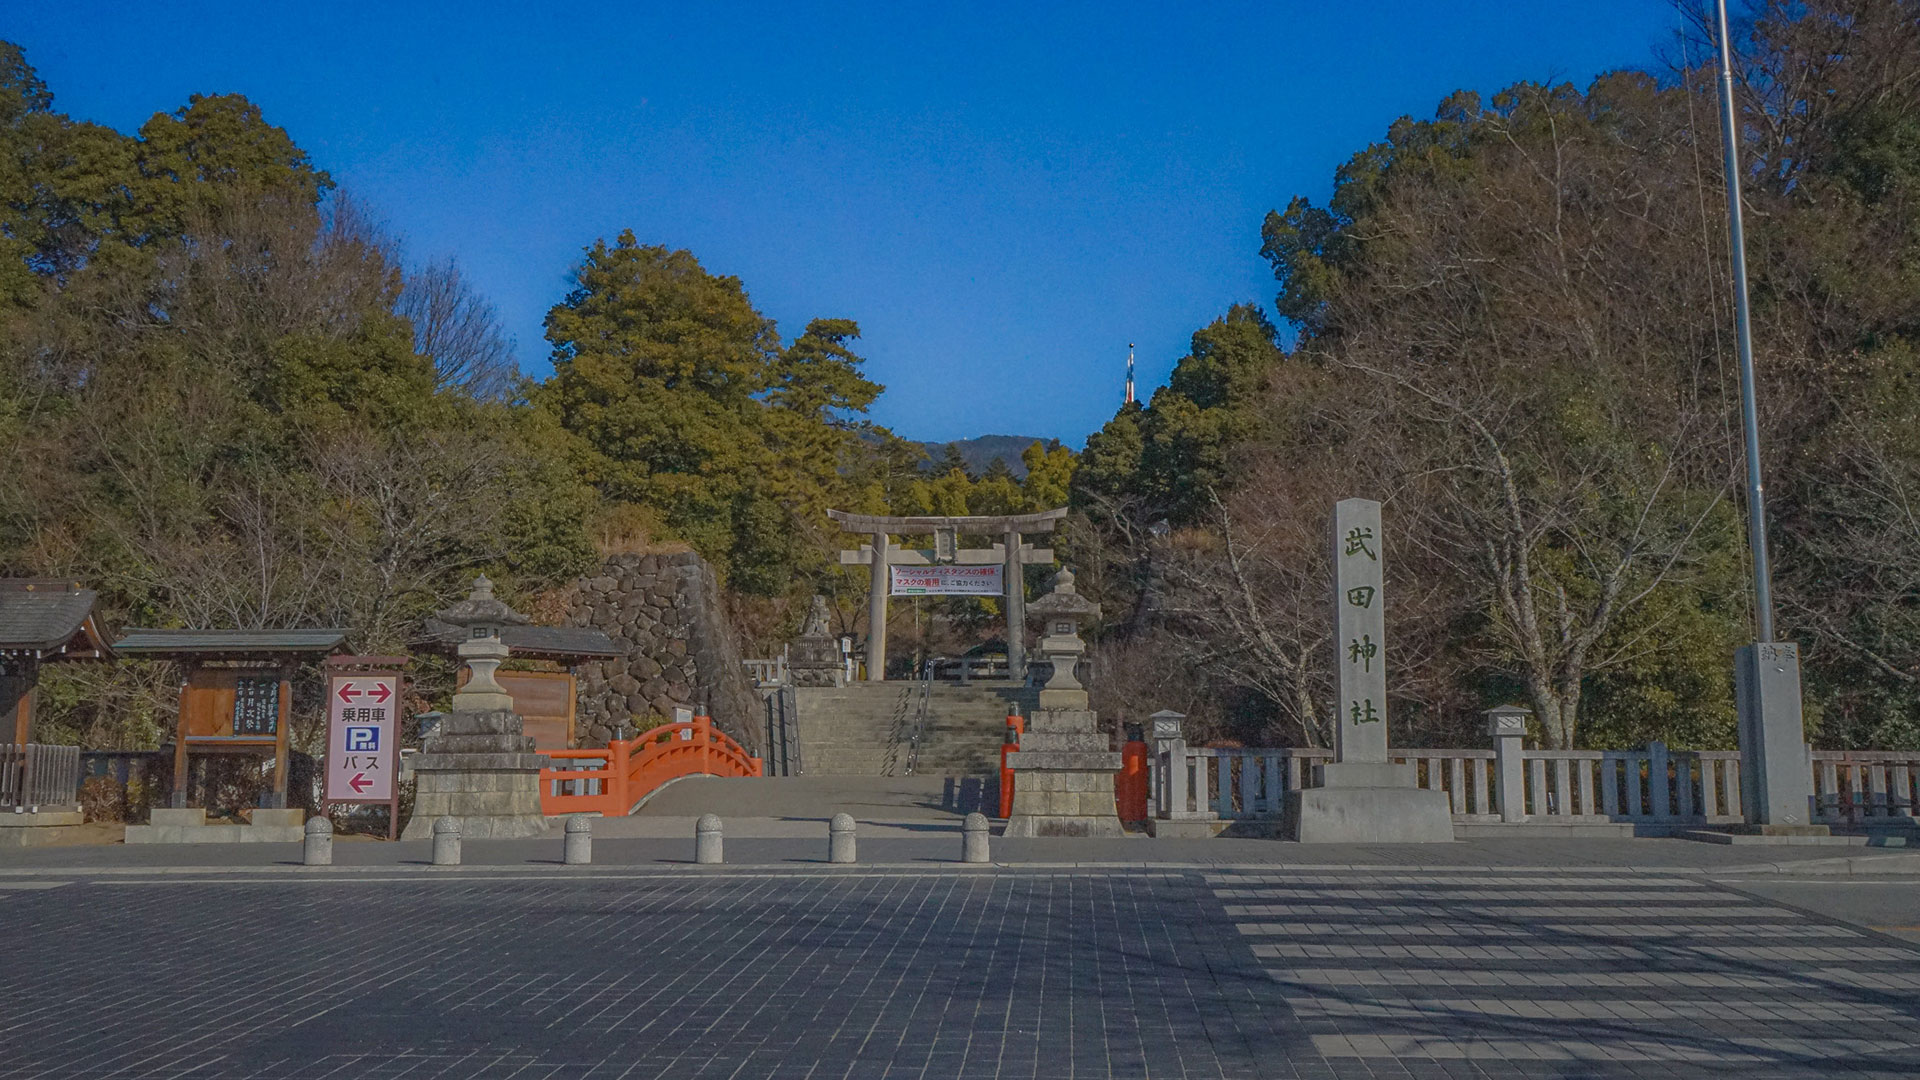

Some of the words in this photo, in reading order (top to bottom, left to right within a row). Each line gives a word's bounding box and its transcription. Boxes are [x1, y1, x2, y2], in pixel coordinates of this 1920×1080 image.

[1345, 527, 1380, 727] 武田神社
[341, 707, 386, 722] 乗用車
[350, 728, 373, 751] P
[343, 756, 379, 770] バス
